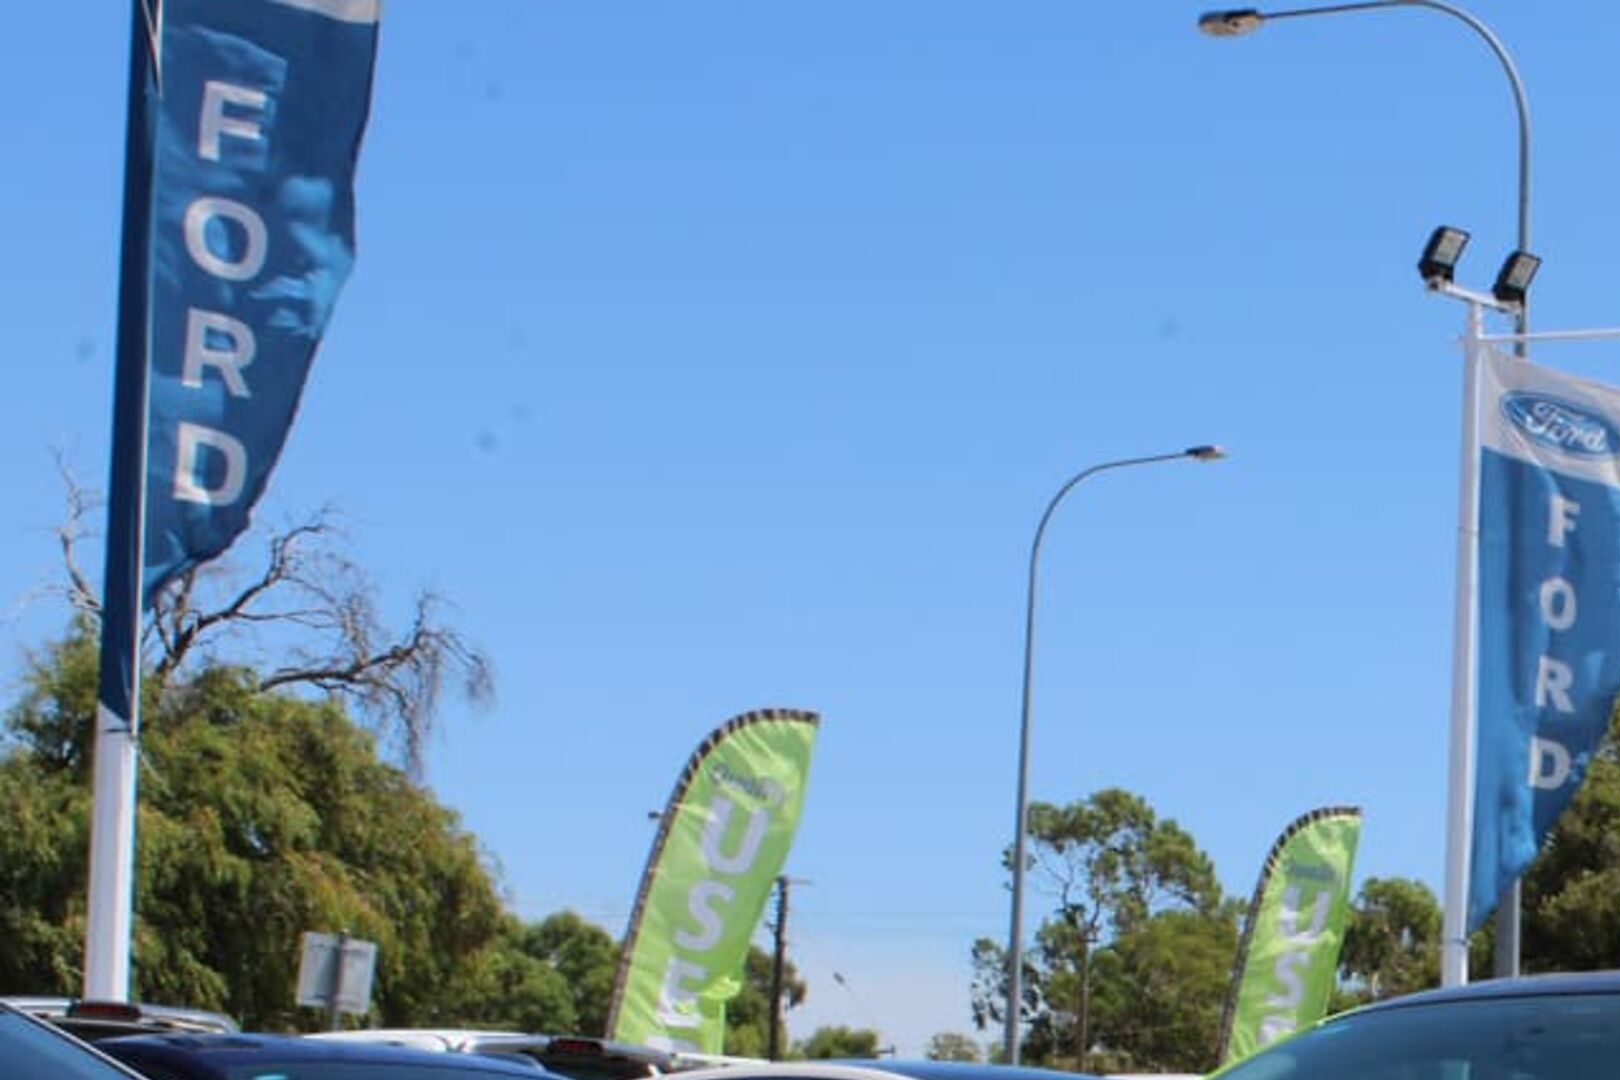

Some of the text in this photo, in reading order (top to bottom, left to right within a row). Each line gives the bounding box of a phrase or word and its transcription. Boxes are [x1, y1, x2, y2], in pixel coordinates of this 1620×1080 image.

[173, 79, 268, 508] FORD
[1525, 402, 1607, 452] Ford
[1527, 495, 1581, 791] FORD
[645, 796, 770, 1053] USE
